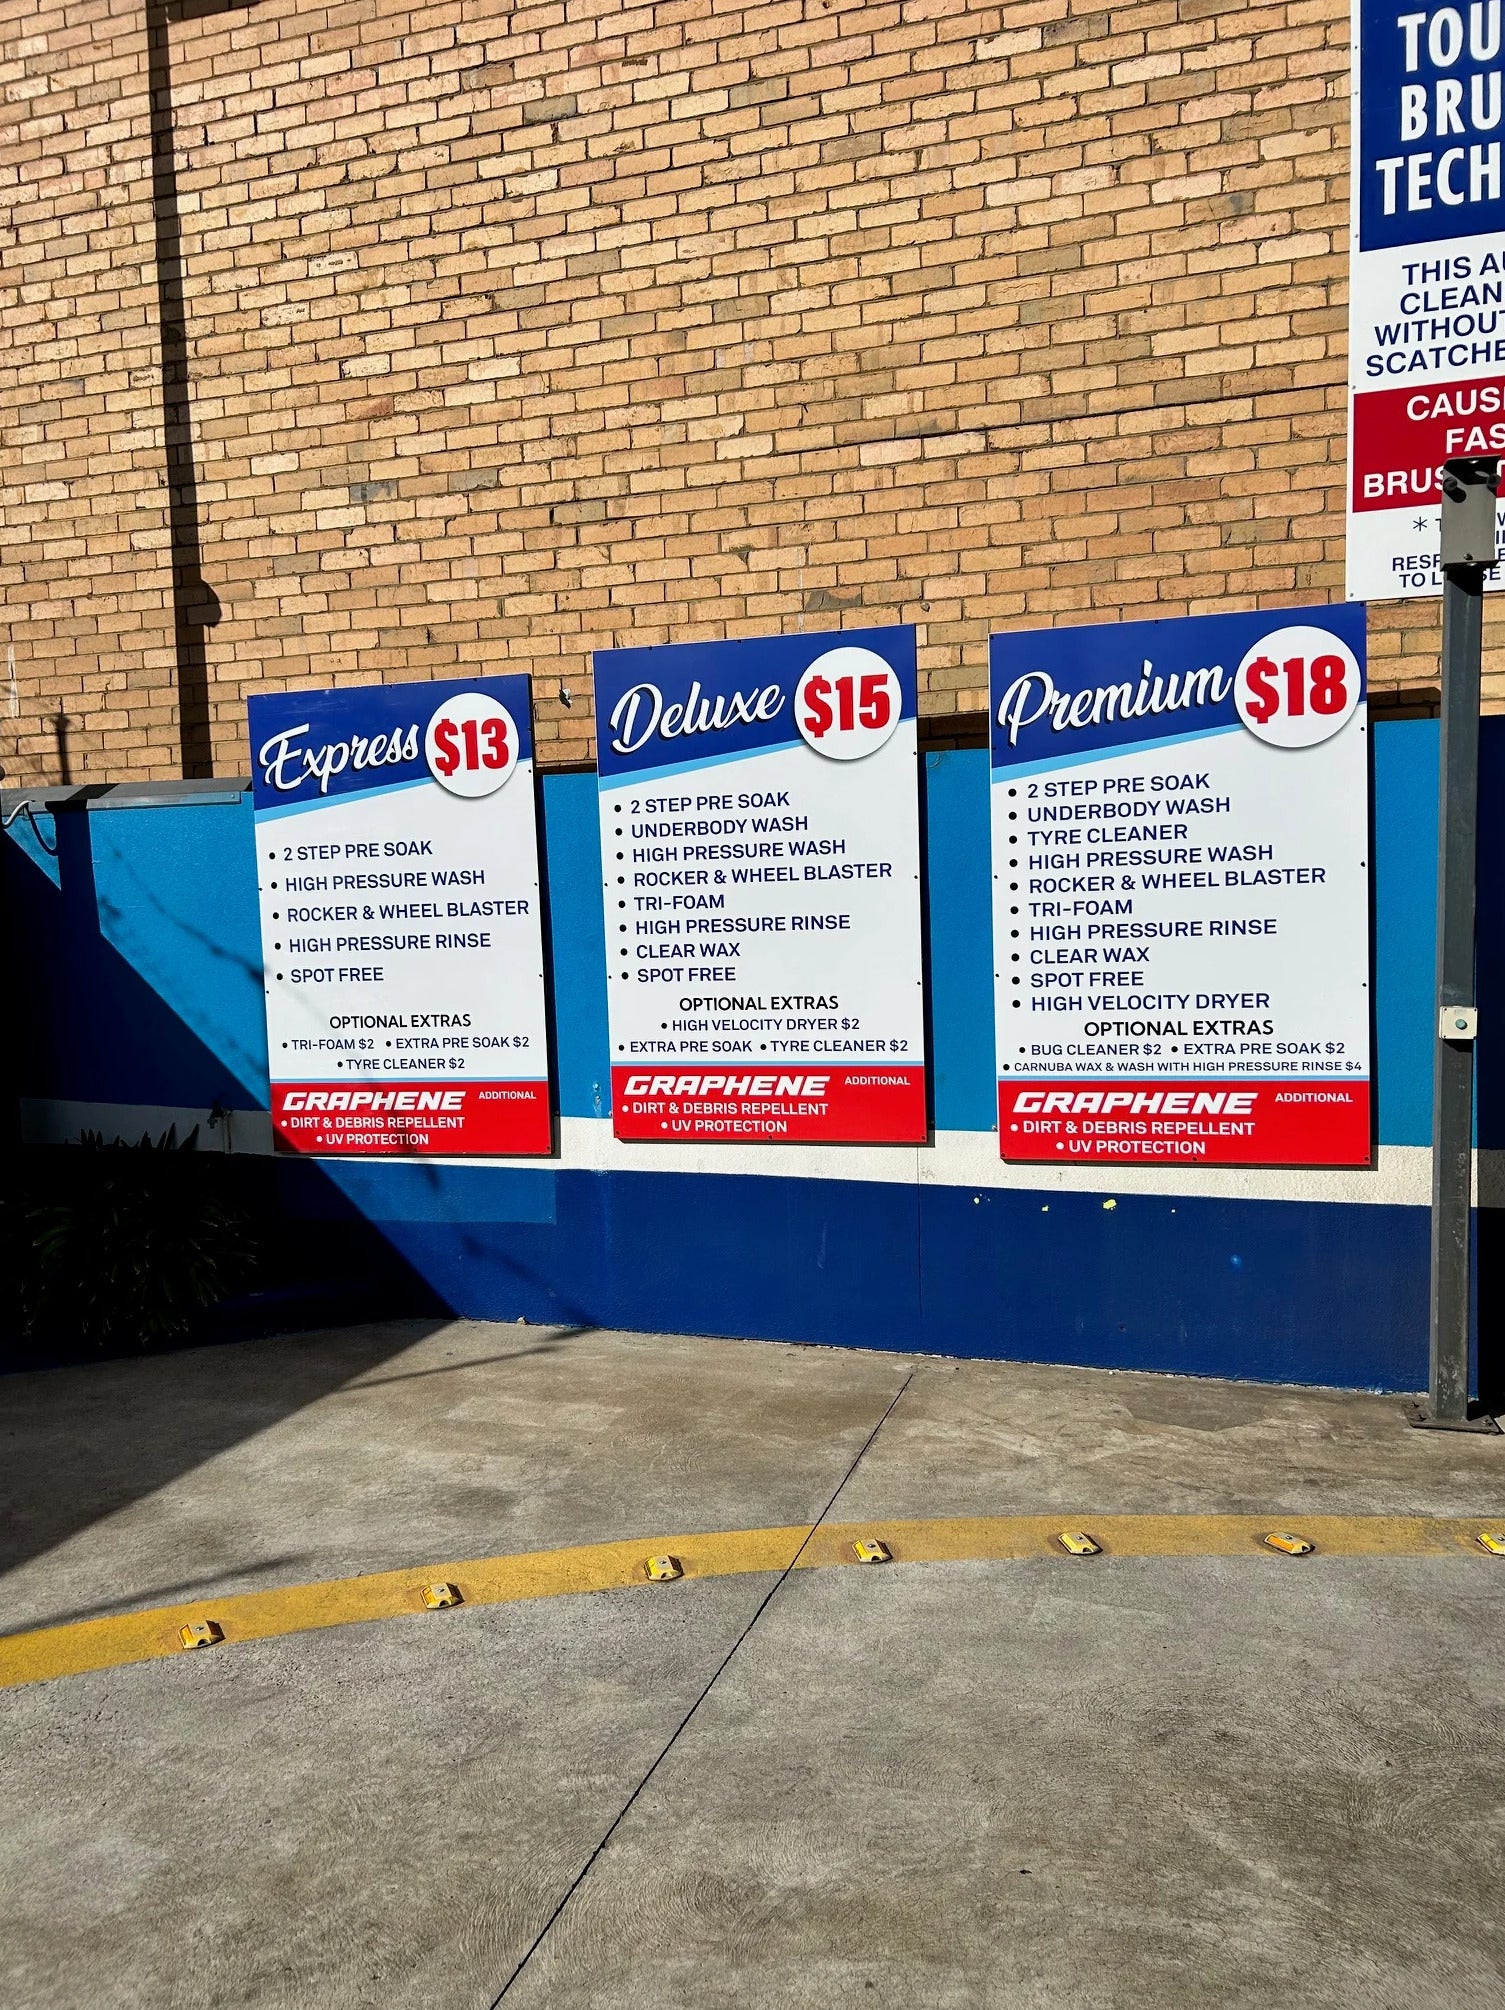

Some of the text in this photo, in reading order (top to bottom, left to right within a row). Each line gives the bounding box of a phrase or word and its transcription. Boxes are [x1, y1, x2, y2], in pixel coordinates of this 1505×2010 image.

[1376, 142, 1500, 215] TECH
[1402, 251, 1505, 285] THIS A
[1407, 387, 1505, 421] CAUS
[1364, 467, 1444, 498] BRU
[1399, 573, 1426, 588] TO
[998, 654, 1348, 747] Premium $18
[610, 673, 890, 753] Deluxe $15
[259, 718, 510, 794] Express $13
[1028, 773, 1209, 798] 2 STEP PRE SOAK
[631, 792, 789, 813] 2 STEP PRE SOAK
[1029, 797, 1229, 822] UNDERBODY WASH
[632, 816, 807, 838] UNDERBODY WASH
[1028, 824, 1187, 846] TYRE CLEANER
[284, 841, 432, 861] 2 STEP PRE SOAK
[633, 840, 845, 862] HIGH PRESSURE WASH
[1030, 845, 1272, 869] HIGH PRESSURE WASH
[286, 870, 484, 891] HIGH PRESSURE WASH
[635, 863, 891, 887] ROCKER & WHEEL BLASTER
[1030, 868, 1325, 893] ROCKER & WHEEL BLASTER
[288, 900, 528, 922] ROCKER & WHEEL BLASTER
[634, 895, 724, 910] TRI-FOAM
[1029, 900, 1132, 917] TRI-FOAM
[636, 915, 850, 934] HIGH PRESSURE RINSE
[1031, 919, 1277, 940] HIGH PRESSURE RINSE
[290, 933, 491, 952] HIGH PRESSURE RINSE
[637, 943, 740, 958] CLEAR WAX
[1031, 947, 1149, 964] CLEAR WAX
[291, 967, 384, 983] SPOT FREE
[638, 967, 736, 982] SPOT FREE
[1031, 972, 1143, 987] SPOT FREE
[680, 996, 838, 1011] OPTIONAL EXTRAS
[1032, 993, 1269, 1011] HIGH VELOCITY DRYER
[330, 1014, 471, 1028] OPTIONAL EXTRAS
[673, 1017, 859, 1031] HIGH VELOCITY DRYER $2
[1084, 1020, 1273, 1036] OPTIONAL EXTRAS
[291, 1036, 529, 1050] TRI-FOAM $2 EXTRA PRE SOAK $2
[631, 1039, 908, 1052] EXTRA PRE SOAK TYRE CLEANER $2
[1032, 1042, 1344, 1056] BUG CLEANER $2 EXTRA PRE SOAK $2
[346, 1057, 464, 1069] TYRE CLEANER $2
[1015, 1061, 1362, 1071] CARNUBA WAX & WASH WITH HIGH PRESSURE RINSE $4
[624, 1076, 830, 1096] GRAPHENE
[845, 1076, 910, 1085] ADDITIONAL
[283, 1092, 466, 1110] GRAPHENE
[479, 1091, 536, 1099] ADDITIONAL
[1013, 1092, 1258, 1114] GRAPHENE
[1275, 1093, 1353, 1102] ADDITIONAL
[633, 1102, 828, 1115] DIRT & DEBRIS REPELLENT
[291, 1117, 465, 1128] DIRT & DEBRIS REPELLENT
[672, 1120, 787, 1132] UV PROTECTION
[1024, 1121, 1255, 1135] DIRT & DEBRIS REPELLENT
[326, 1134, 428, 1144] UV PROTECTION
[1069, 1140, 1205, 1154] UV PROTECTION
